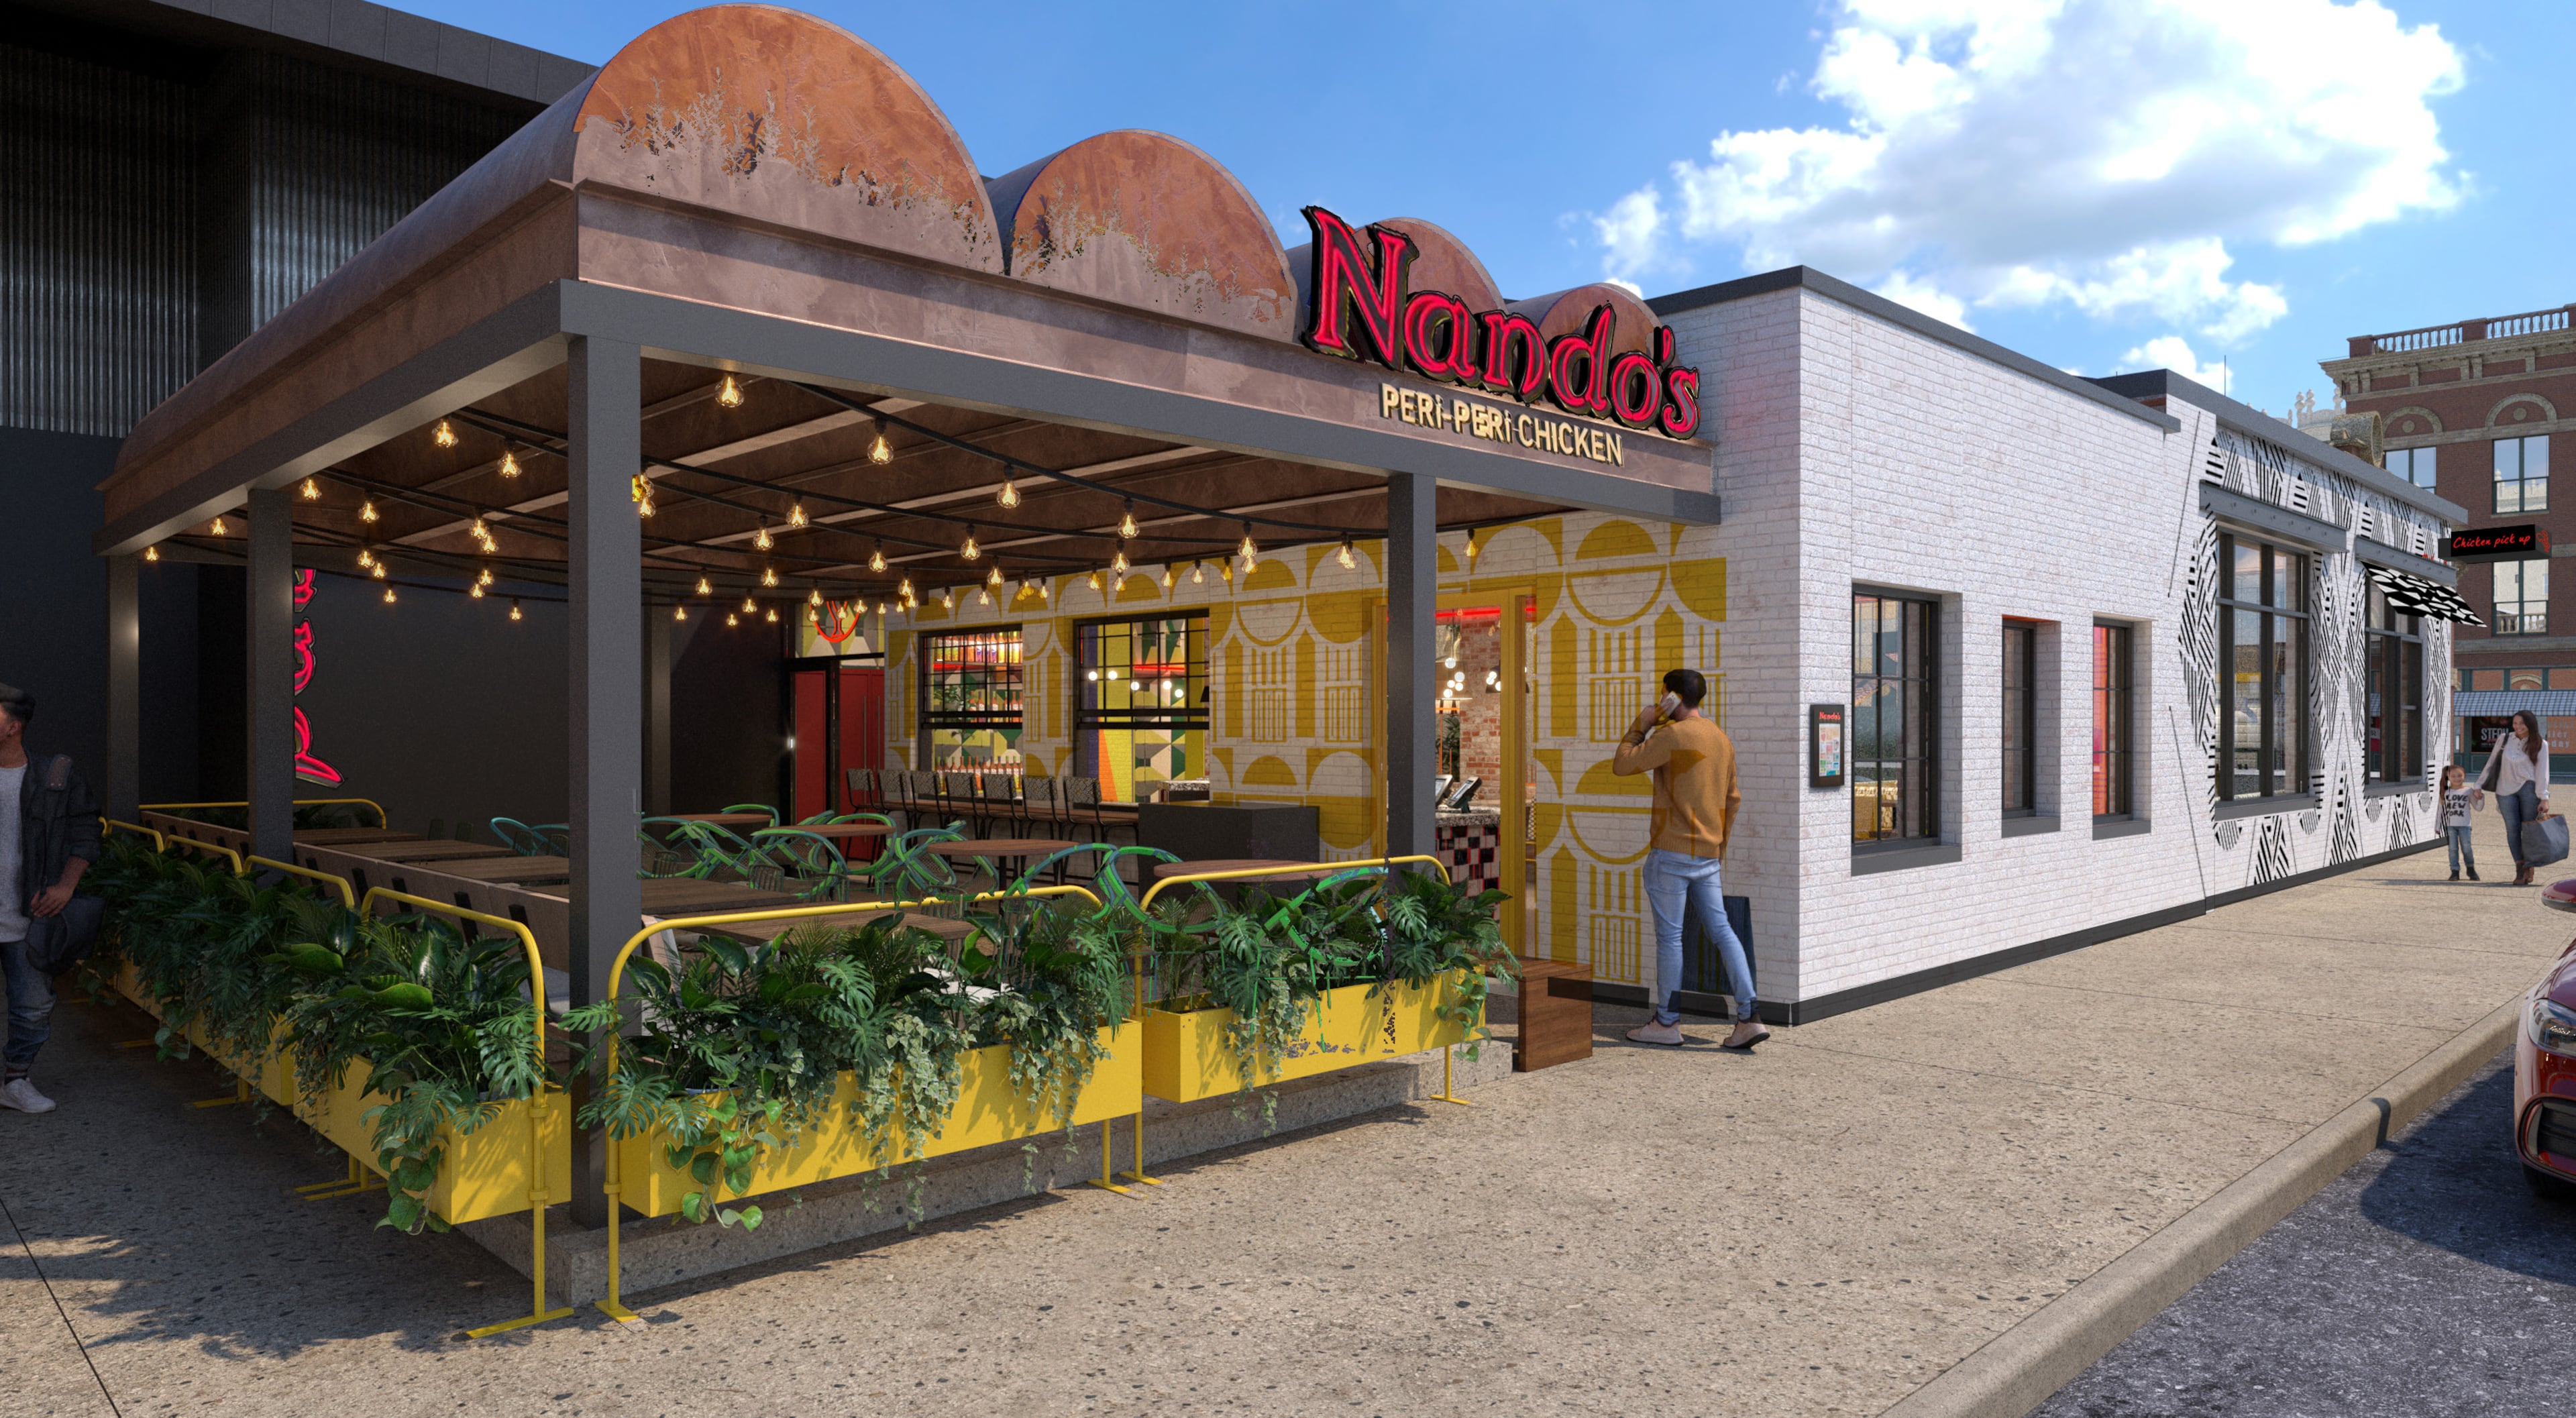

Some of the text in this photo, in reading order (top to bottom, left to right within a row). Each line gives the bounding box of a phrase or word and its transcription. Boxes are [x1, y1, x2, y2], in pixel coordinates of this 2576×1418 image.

[1300, 205, 1701, 440] Nando's
[1517, 414, 1625, 468] CHICKEN
[2452, 533, 2531, 549] Chicken pick up
